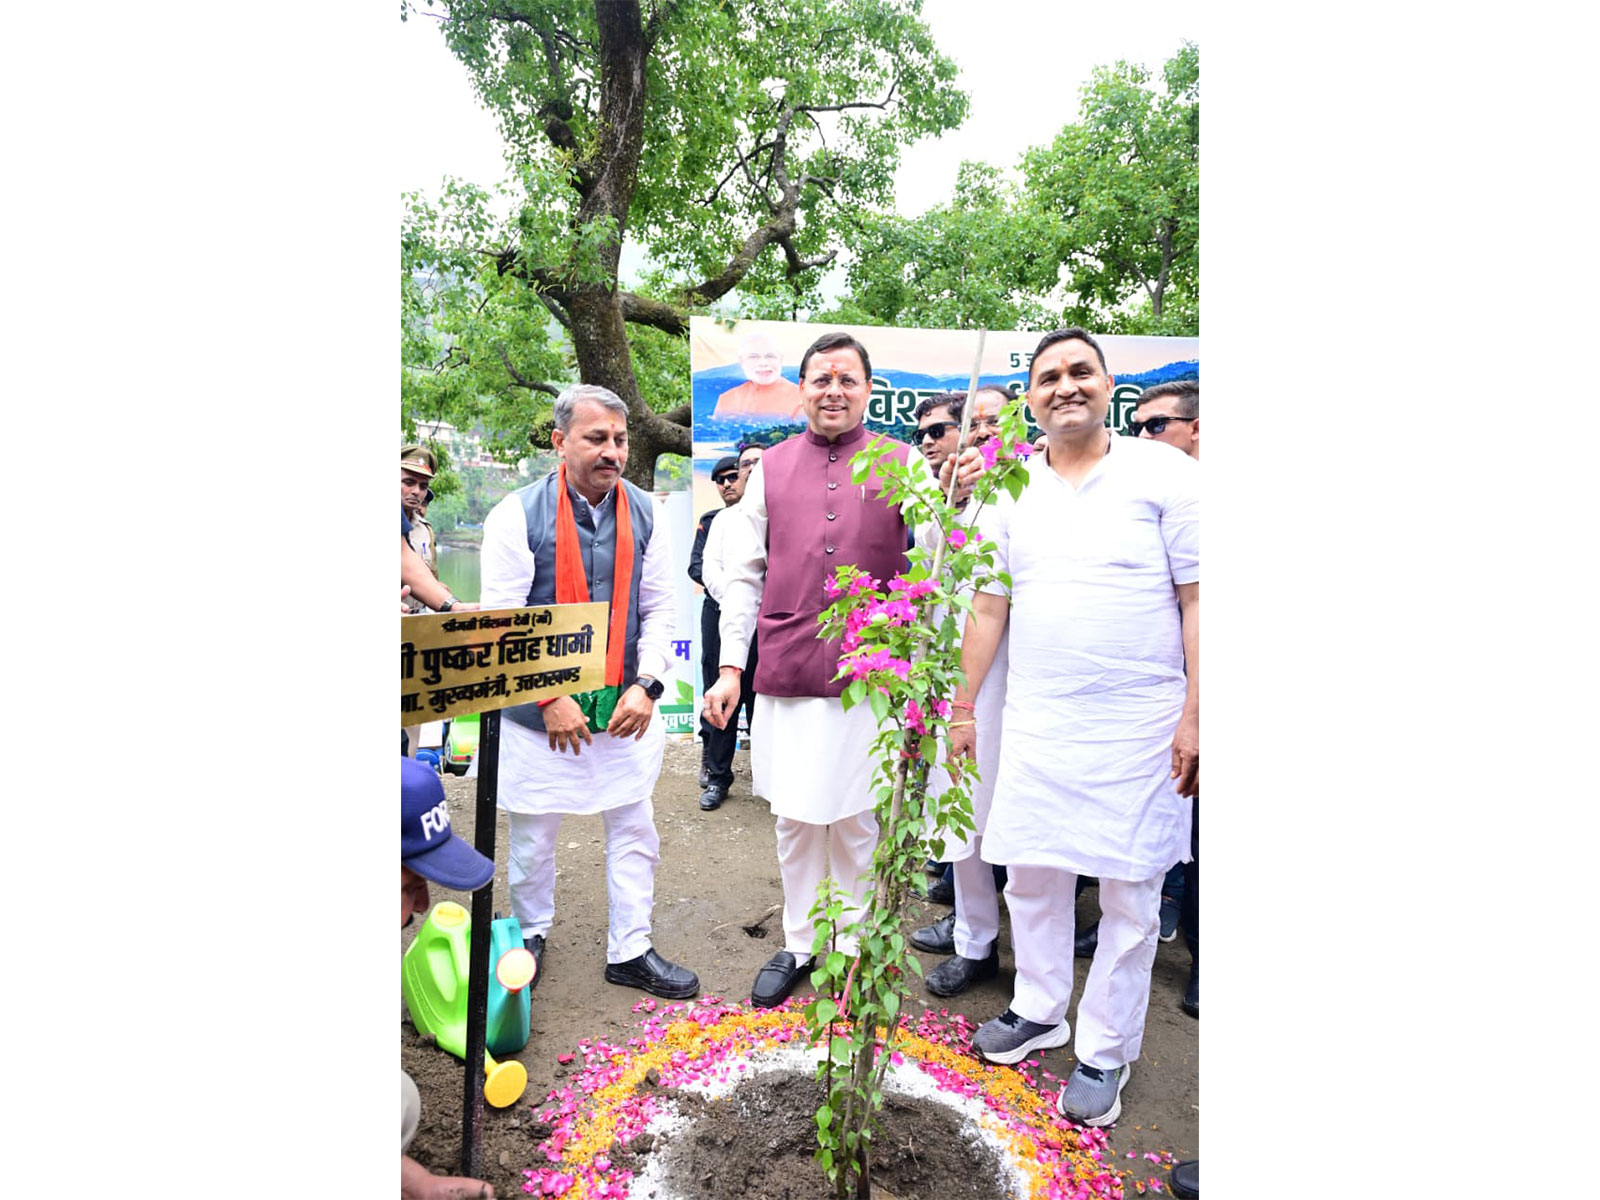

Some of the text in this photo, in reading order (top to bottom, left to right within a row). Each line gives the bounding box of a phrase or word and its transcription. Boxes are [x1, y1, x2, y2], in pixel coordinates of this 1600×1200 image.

[1010, 352, 1020, 368] 5
[513, 612, 530, 627] देवी
[421, 642, 493, 685] पुष्कर
[497, 628, 543, 665] सिंह
[545, 623, 594, 657] धामी
[513, 666, 581, 692] उत्तराखण्ड
